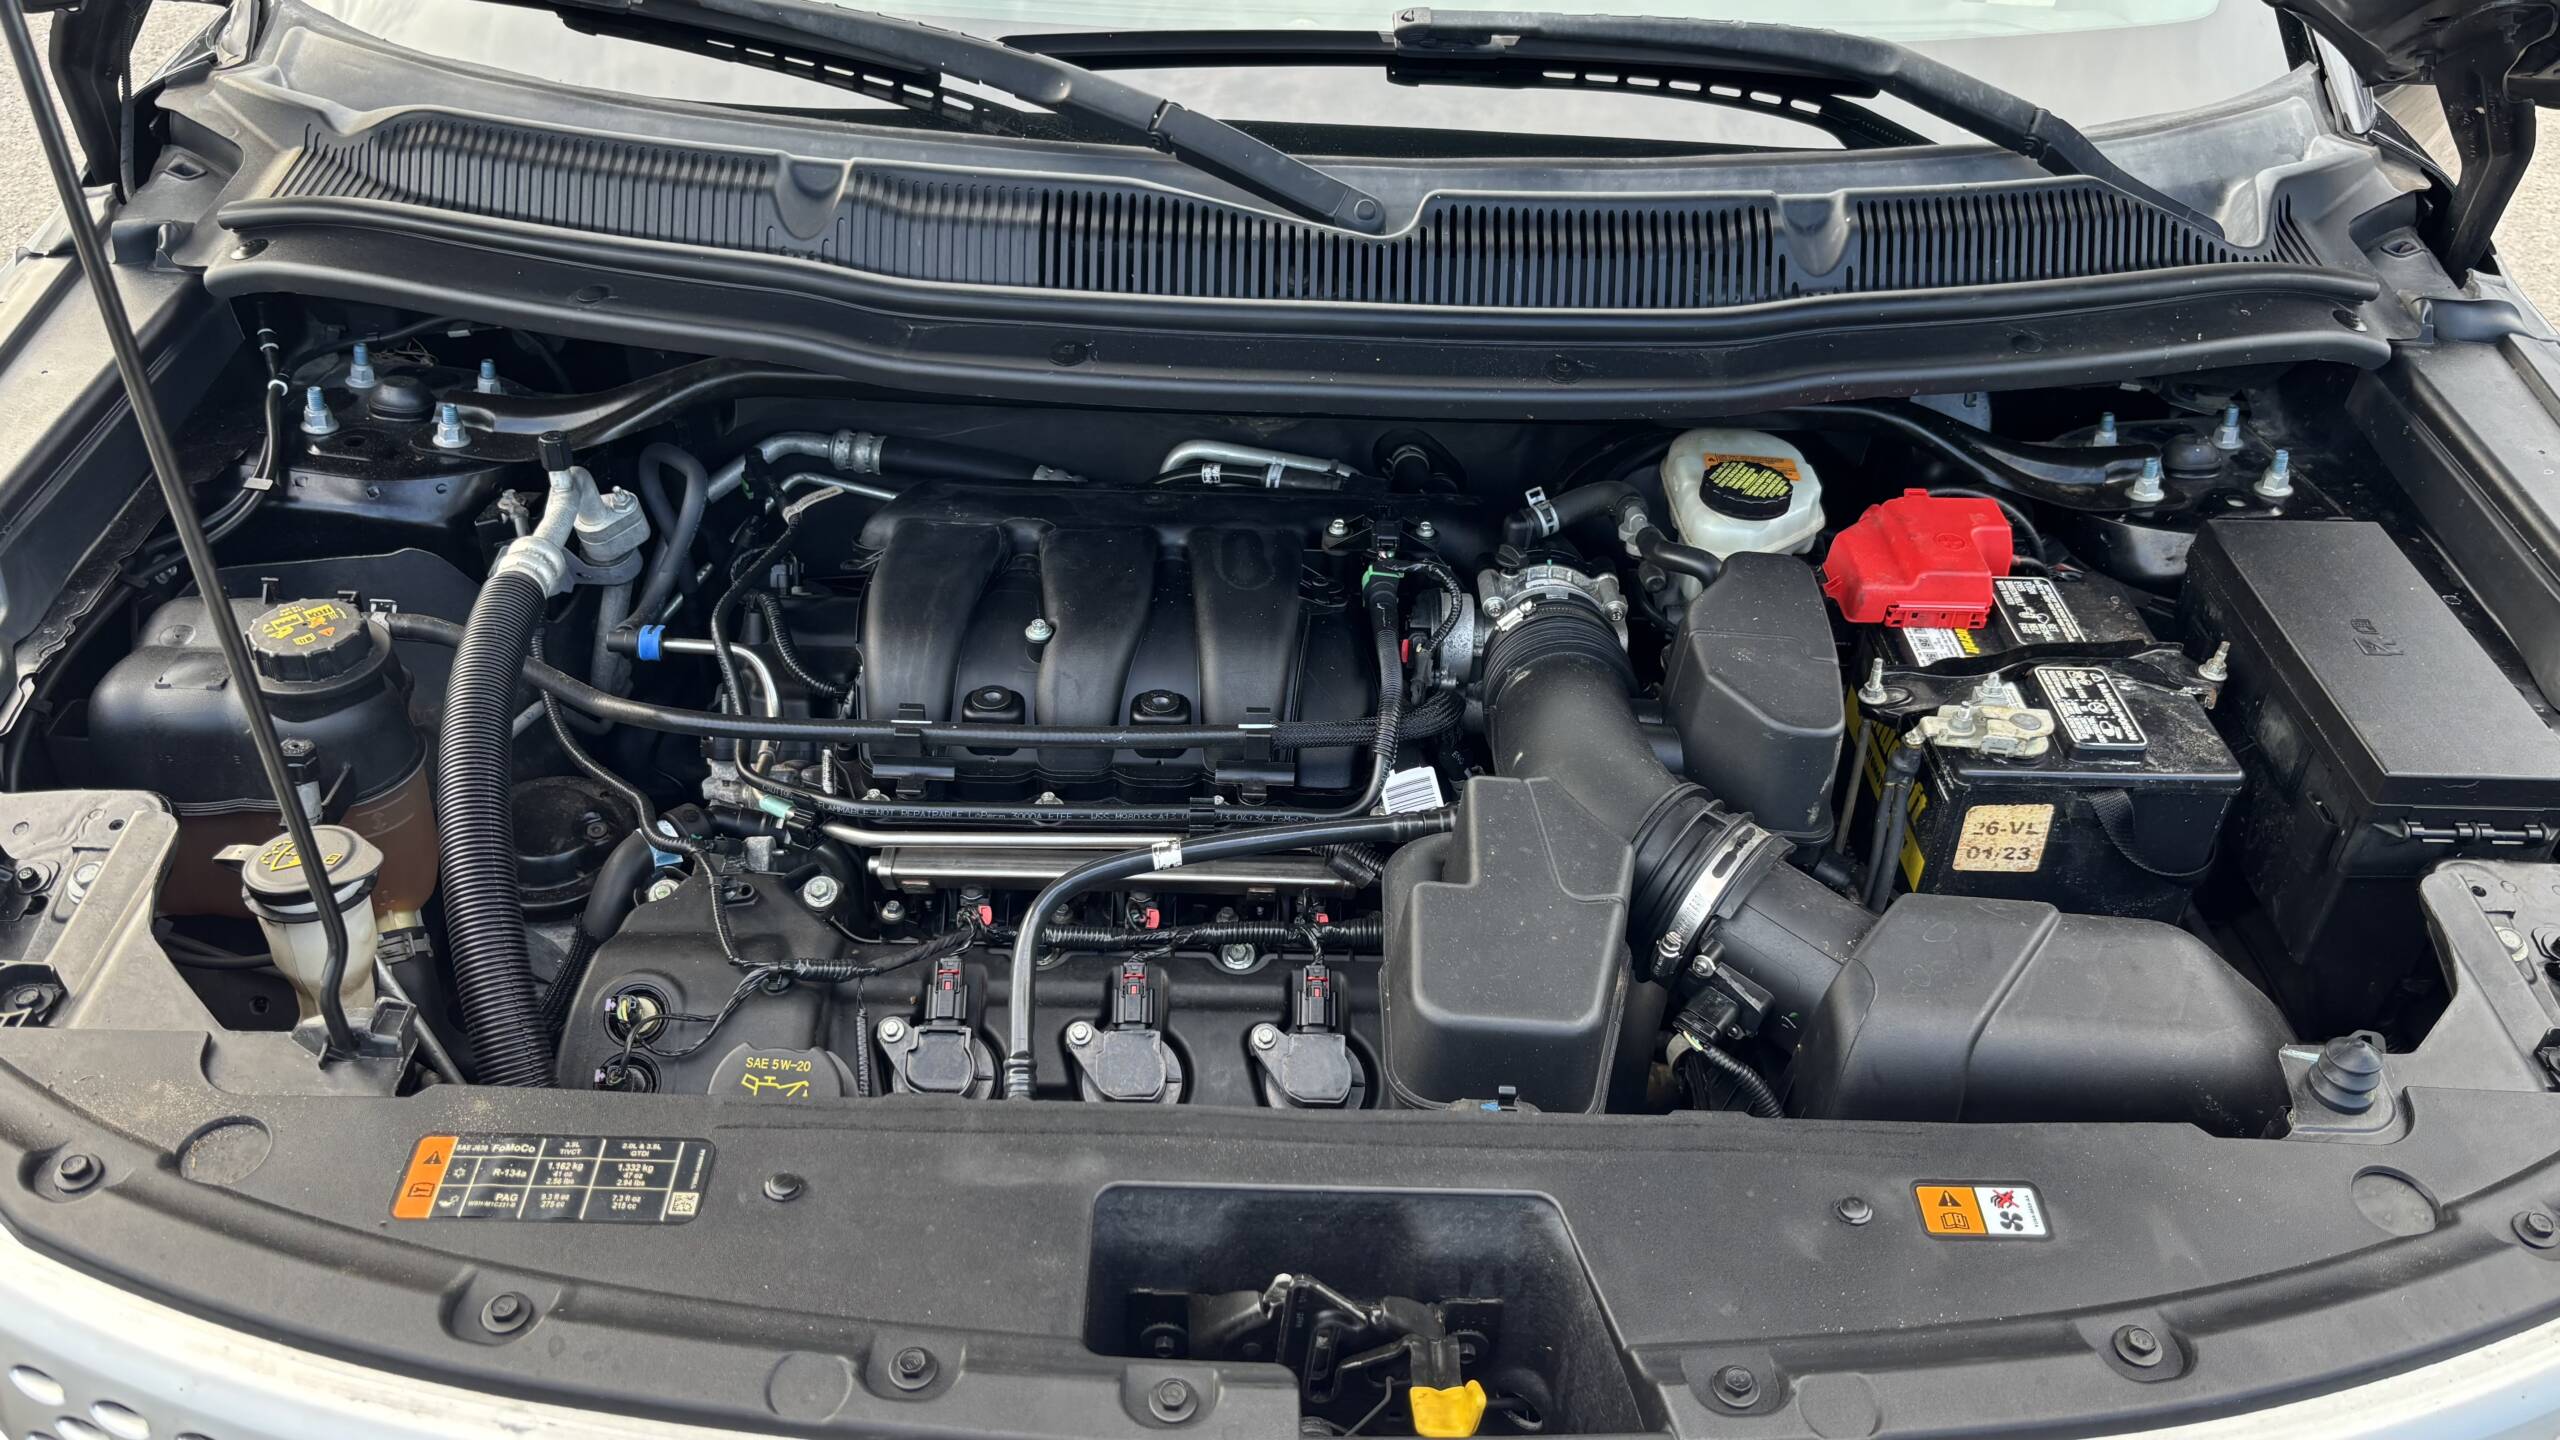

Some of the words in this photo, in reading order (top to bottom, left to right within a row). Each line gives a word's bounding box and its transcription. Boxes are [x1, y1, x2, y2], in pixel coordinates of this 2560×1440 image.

[745, 1056, 769, 1070] SAE
[771, 1058, 812, 1072] 5W-20
[491, 1143, 536, 1153] FoMoCo
[572, 1162, 584, 1172] kg
[617, 1163, 641, 1172] 1.332
[642, 1164, 655, 1174] kg
[492, 1167, 527, 1178] R-134a
[494, 1192, 519, 1202] PAG
